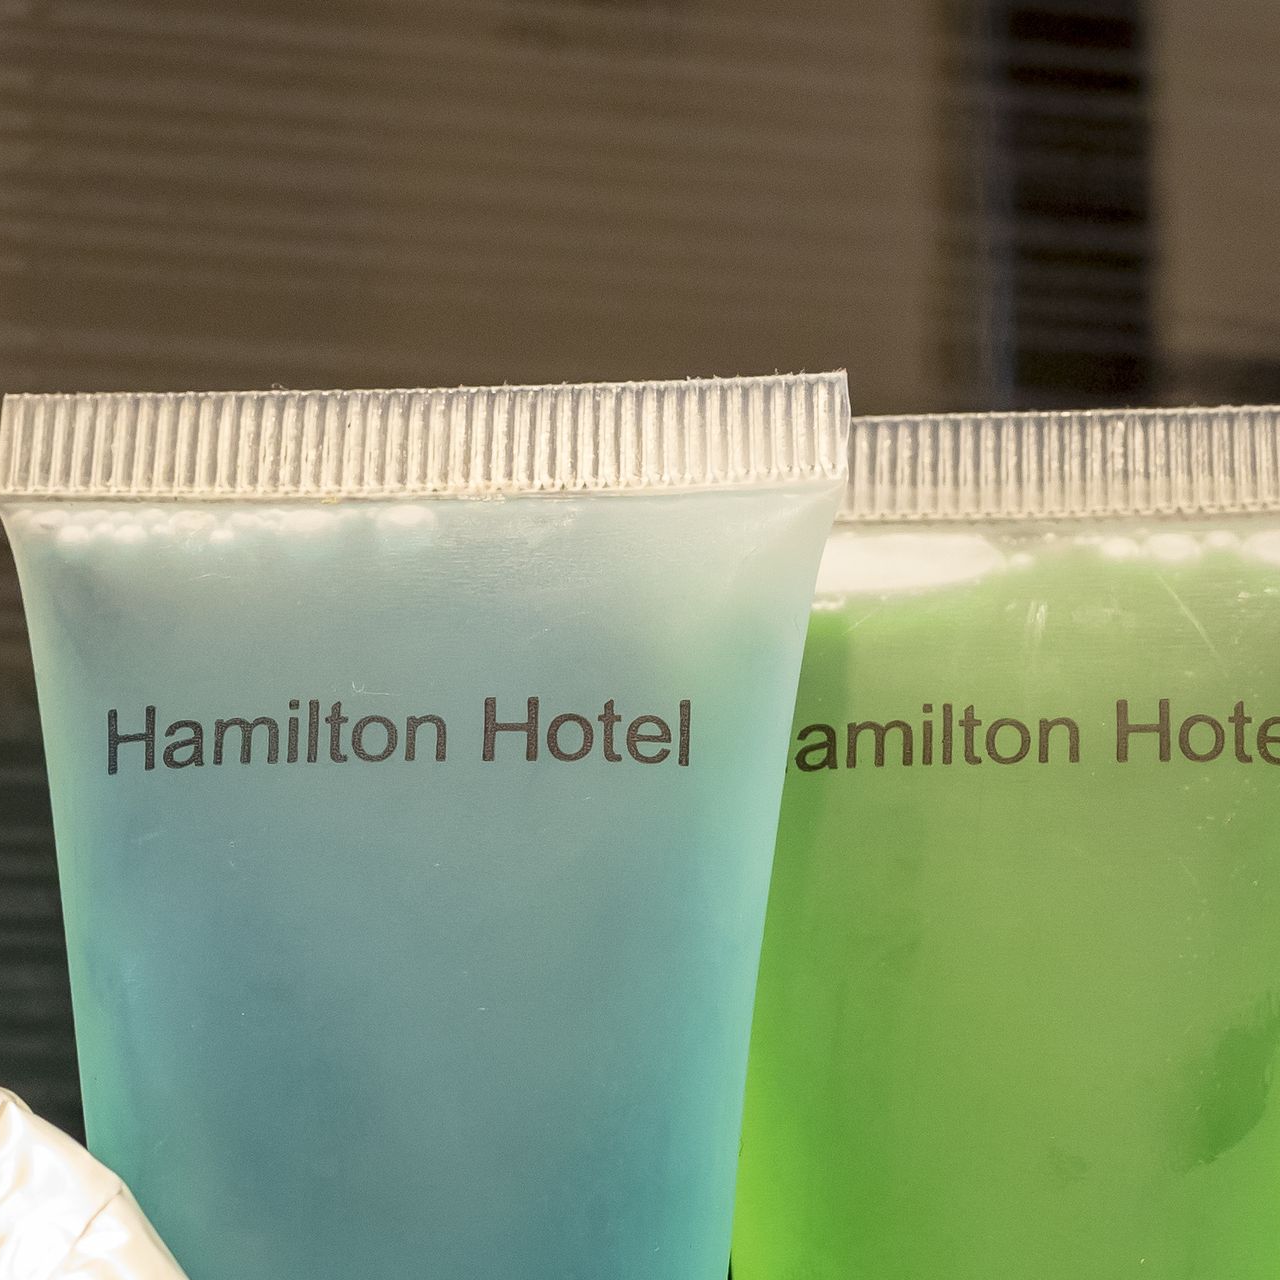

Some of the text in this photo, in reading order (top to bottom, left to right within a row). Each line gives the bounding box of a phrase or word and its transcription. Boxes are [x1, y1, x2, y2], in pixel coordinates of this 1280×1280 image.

[107, 696, 691, 775] Hamilton Hotel
[785, 703, 1080, 774] amilton
